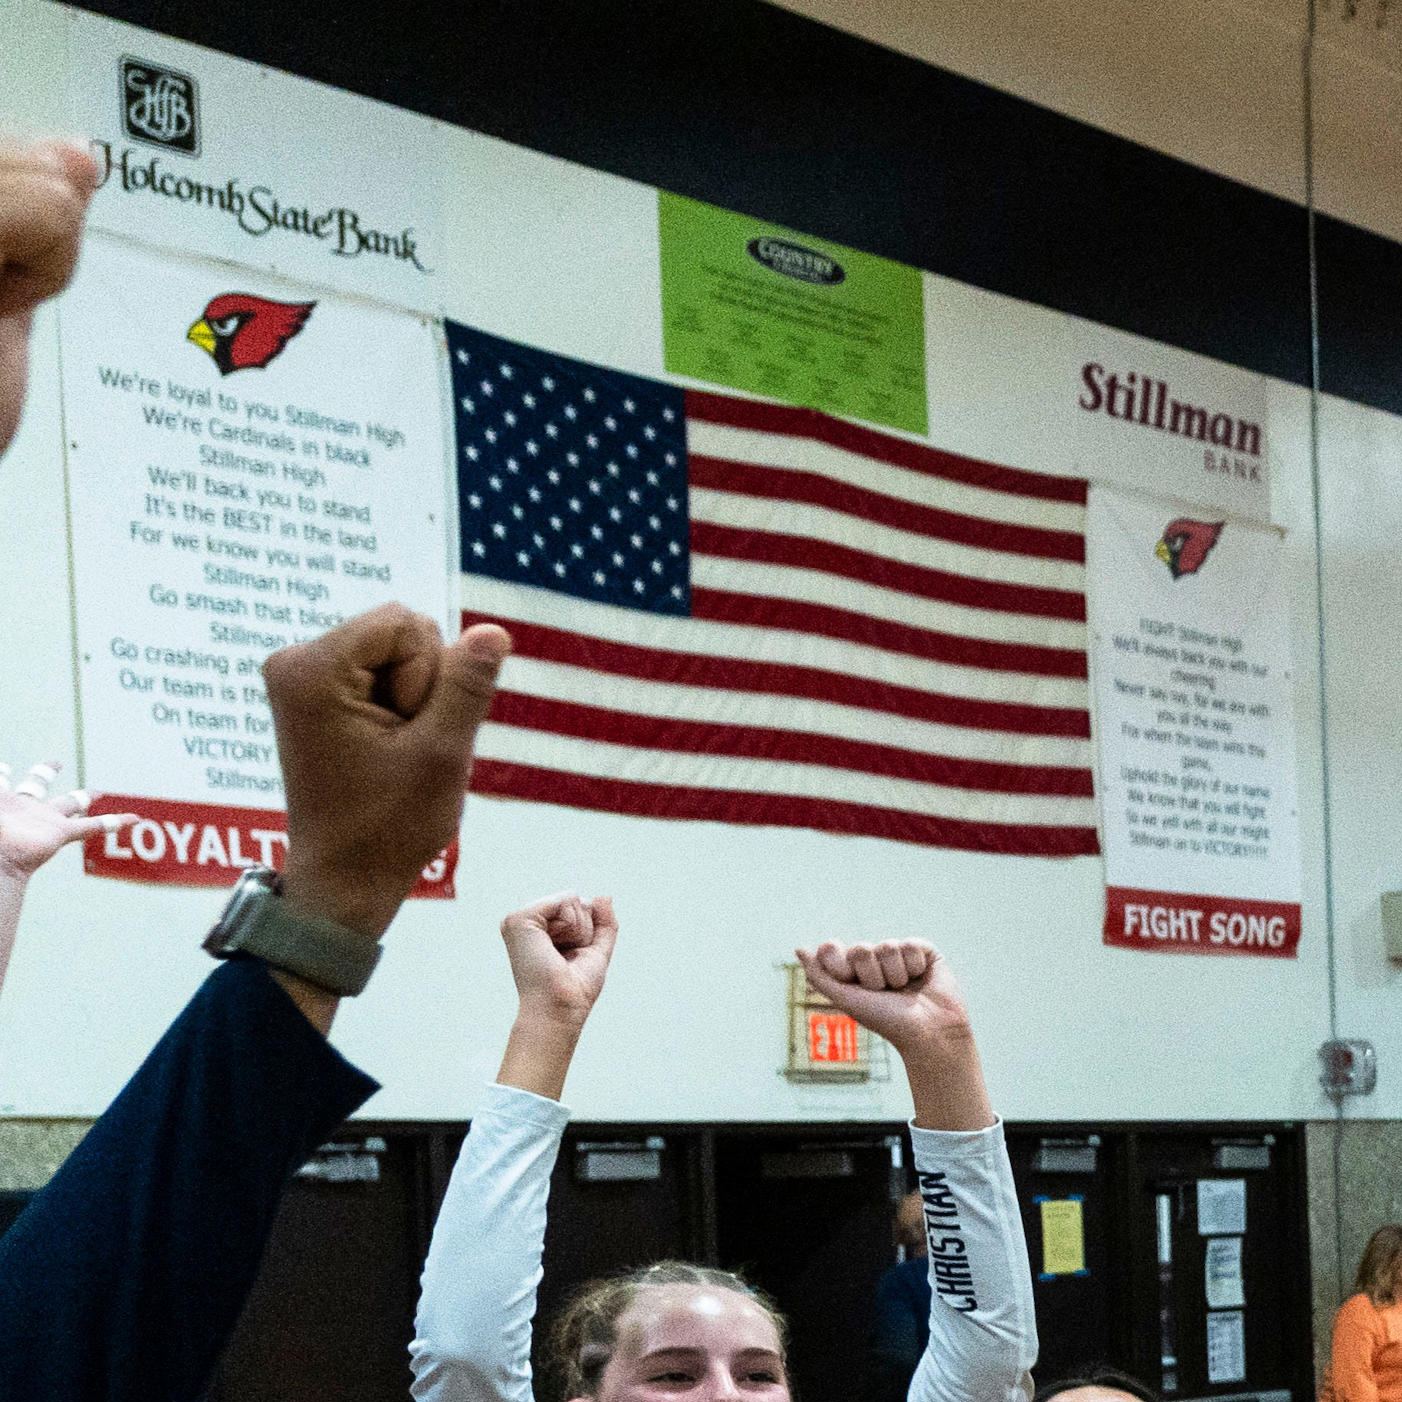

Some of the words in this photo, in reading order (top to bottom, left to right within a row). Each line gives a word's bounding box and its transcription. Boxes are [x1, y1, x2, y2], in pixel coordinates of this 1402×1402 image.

[89, 139, 245, 216] Holcomb
[238, 185, 333, 237] State
[330, 207, 434, 274] Bank
[100, 366, 161, 397] We're
[218, 392, 238, 414] to
[244, 401, 279, 423] you
[366, 423, 406, 449] High
[143, 404, 202, 433] We're
[208, 418, 295, 452] Cardinals
[1079, 361, 1261, 457] Stillman
[148, 465, 197, 491] We'll
[256, 488, 291, 510] you
[298, 495, 317, 515] to
[322, 500, 371, 525] stand
[282, 462, 327, 488] High
[145, 493, 176, 520] It's
[183, 502, 216, 524] the
[223, 507, 272, 533] BEST
[280, 517, 297, 537] in
[303, 523, 333, 545] the
[130, 520, 162, 545] For
[172, 532, 199, 551] we
[207, 534, 259, 560] know
[265, 546, 300, 569] you
[150, 583, 178, 607] Go
[255, 603, 291, 623] that
[286, 577, 329, 602] High
[110, 637, 138, 661] Go
[119, 668, 154, 692] Our
[163, 676, 213, 699] team
[221, 686, 236, 701] is
[152, 702, 181, 725] On
[188, 708, 237, 730] team
[104, 807, 290, 870] LOYALT
[1123, 903, 1204, 943] FIGHT
[1208, 911, 1286, 948] SONG
[919, 1170, 977, 1313] CHRISTIAN
